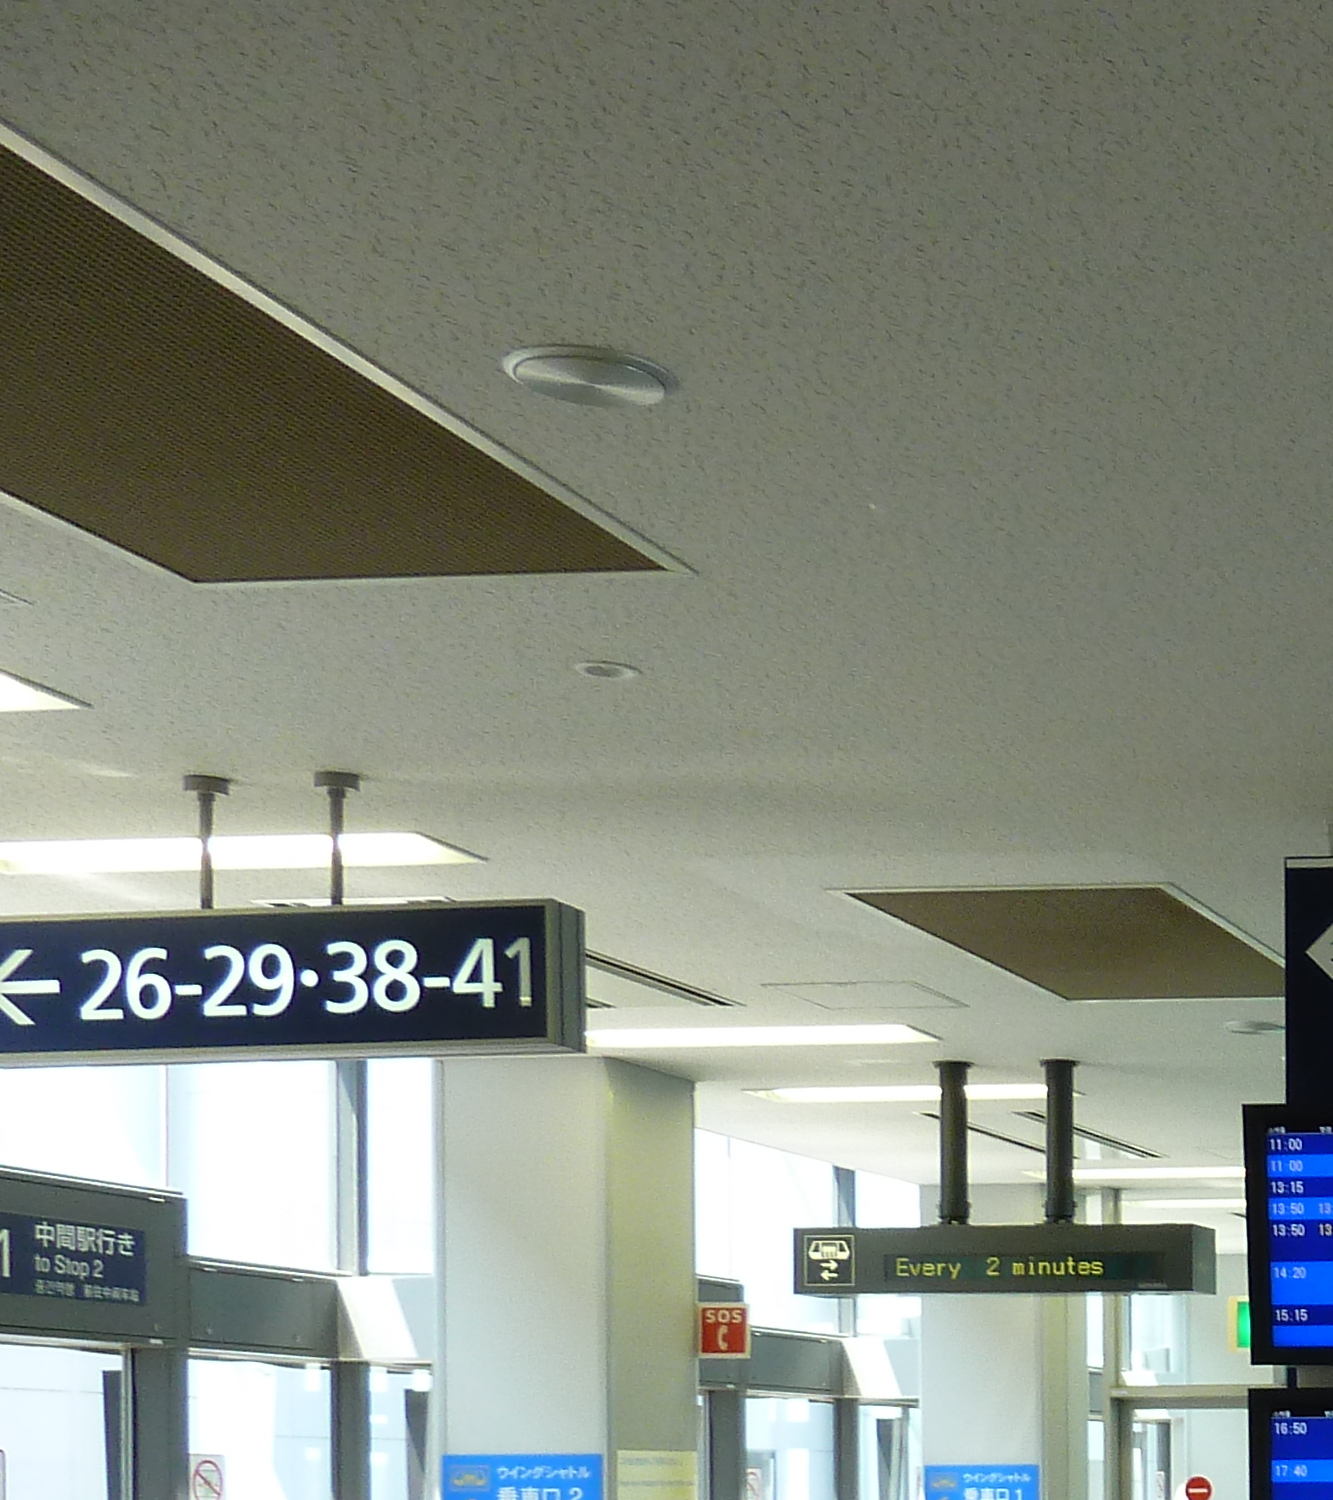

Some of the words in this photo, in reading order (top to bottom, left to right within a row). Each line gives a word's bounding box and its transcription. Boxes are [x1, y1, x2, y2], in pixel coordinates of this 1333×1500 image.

[1271, 1138, 1302, 1150] 11:00
[1273, 1224, 1305, 1236] 13:50
[35, 1221, 135, 1256] 中間駅行き
[34, 1254, 51, 1273] to
[54, 1255, 90, 1279] Stop
[93, 1260, 104, 1278] 2
[895, 1257, 962, 1282] Every
[985, 1257, 1001, 1276] 2
[1012, 1256, 1105, 1277] minutes
[705, 1308, 742, 1324] SOS
[1275, 1422, 1307, 1434] 16:50
